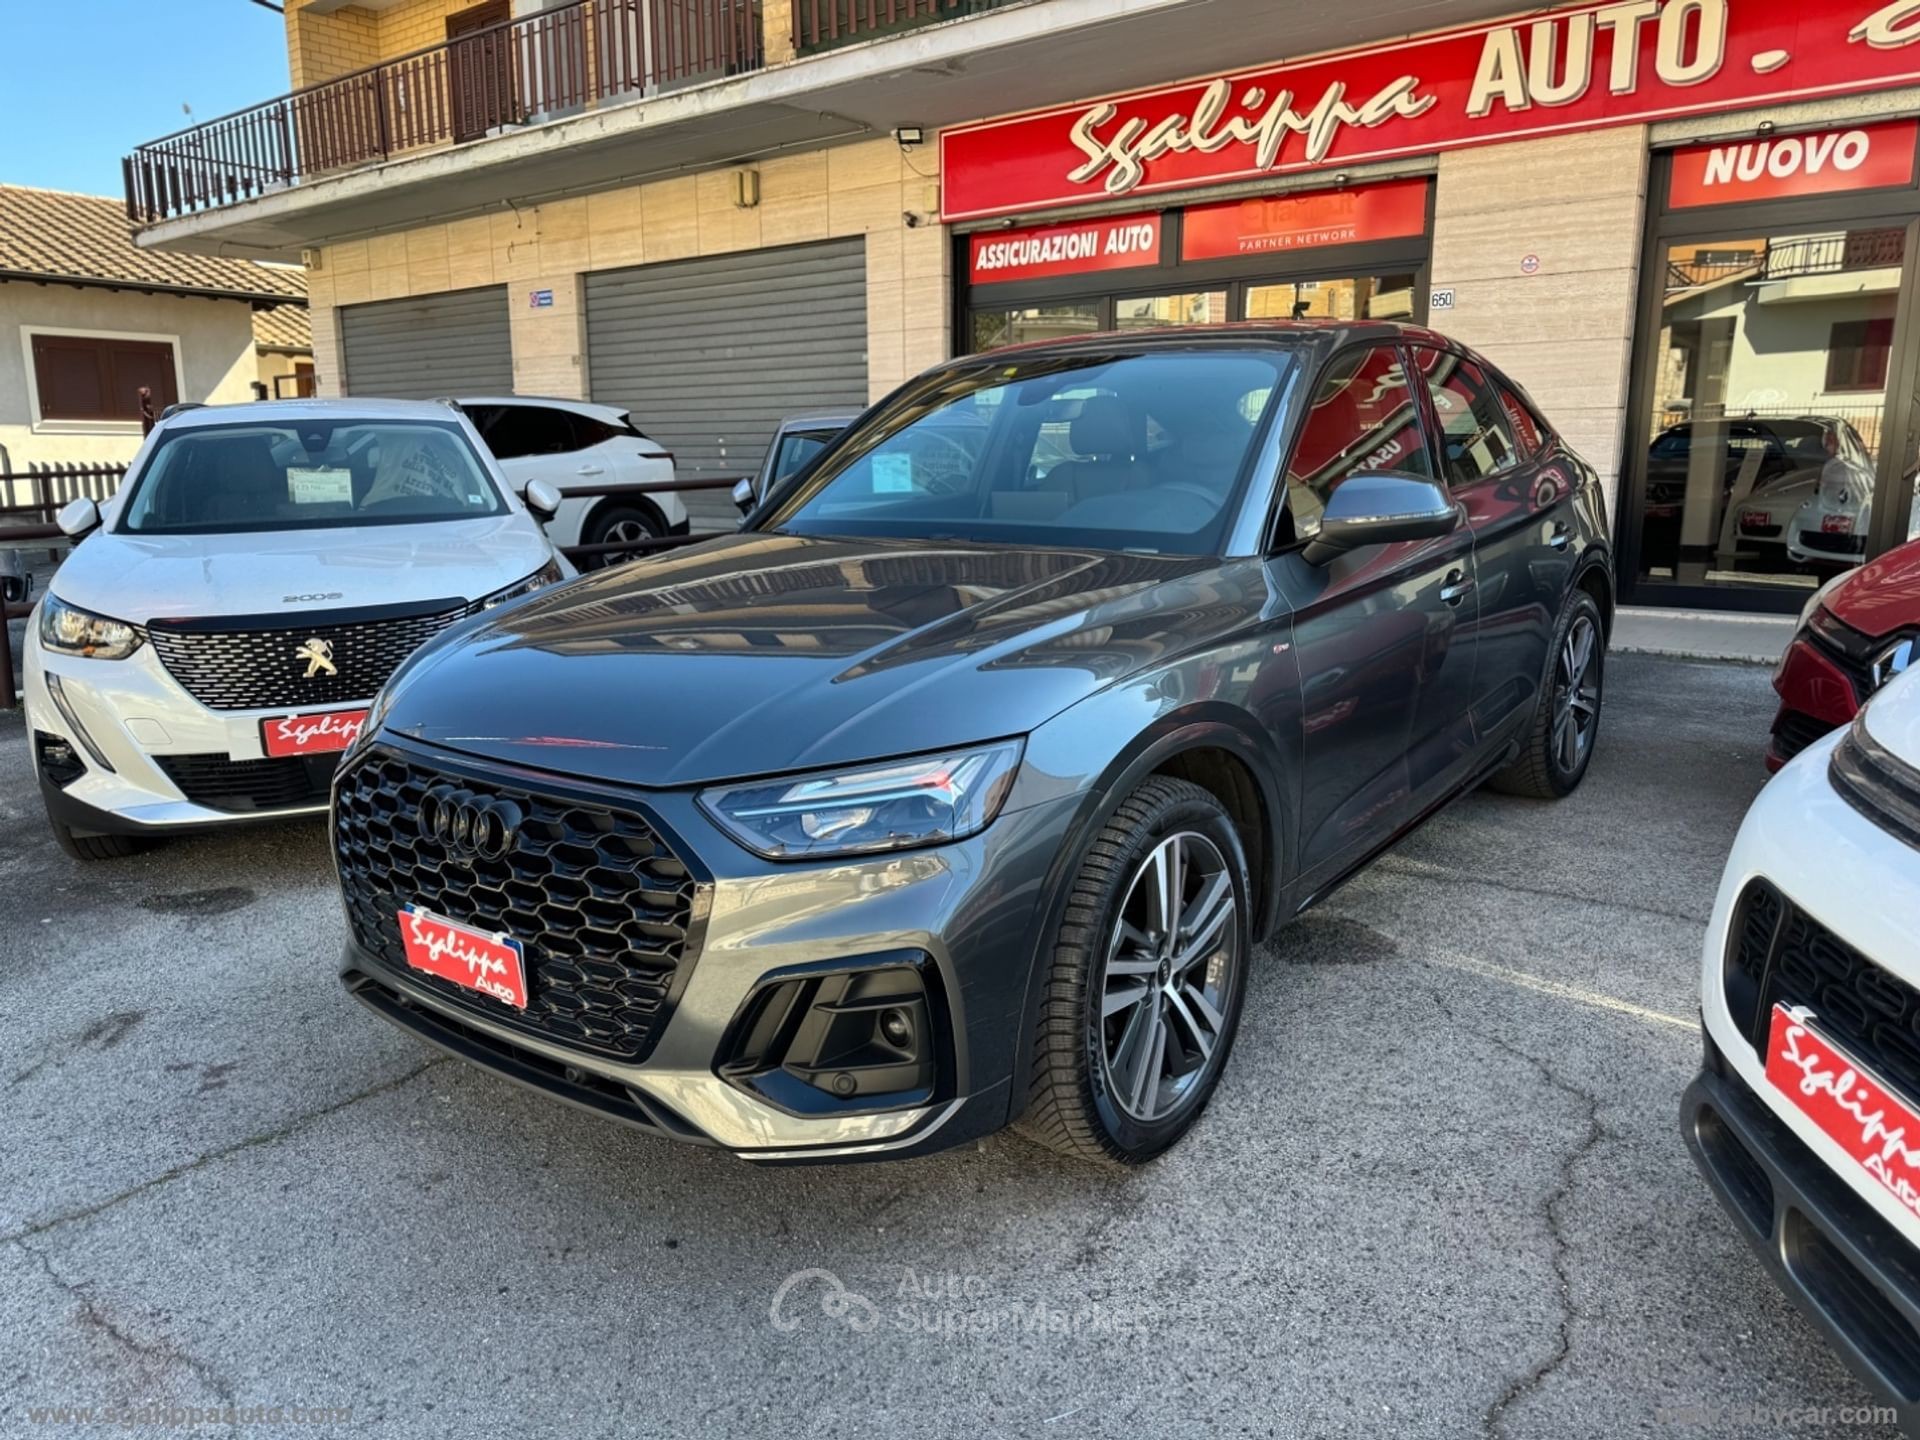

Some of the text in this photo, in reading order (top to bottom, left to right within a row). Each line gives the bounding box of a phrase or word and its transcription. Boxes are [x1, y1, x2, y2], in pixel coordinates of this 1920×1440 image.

[1066, 76, 1437, 194] Sgalippa
[1465, 0, 1728, 119] AUTO
[1703, 130, 1870, 186] NUOVO
[976, 223, 1153, 270] ASSICURAZIONI AUTO
[1239, 229, 1356, 251] PARTNER NETWORK
[1432, 292, 1452, 307] 650
[410, 916, 507, 977] Sgalippa
